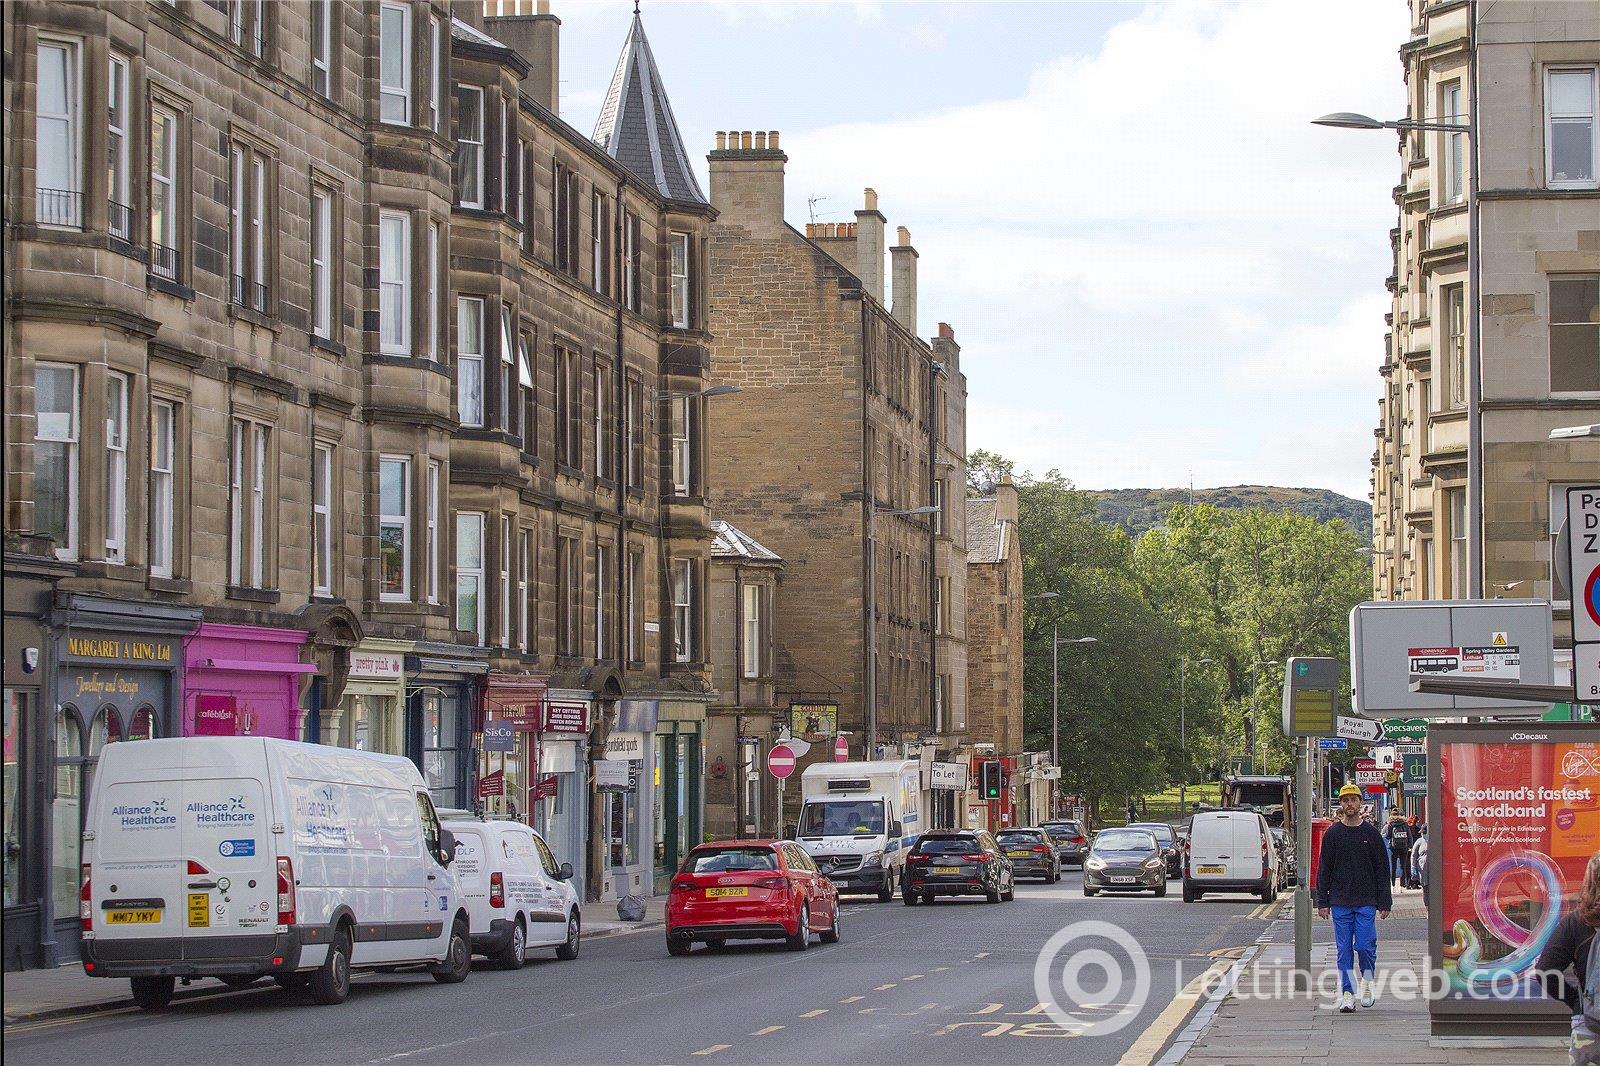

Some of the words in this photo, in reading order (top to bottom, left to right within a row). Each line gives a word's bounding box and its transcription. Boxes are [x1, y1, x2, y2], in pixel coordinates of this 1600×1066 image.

[68, 638, 120, 658] MARGARET
[123, 642, 130, 658] A
[132, 642, 154, 660] KING
[356, 657, 374, 672] pretty
[375, 657, 388, 673] pink
[1344, 719, 1364, 728] Royal
[1384, 724, 1426, 732] Specsavers
[486, 728, 511, 737] SisCo
[943, 770, 955, 778] Let
[629, 779, 635, 789] TO
[1456, 786, 1535, 800] Scotland's
[1538, 786, 1591, 800] fastest
[112, 806, 151, 815] Alliance
[187, 803, 228, 812] Alliance
[1457, 803, 1546, 817] broadband
[121, 815, 176, 825] Healthcare
[197, 812, 254, 822] Healthcare
